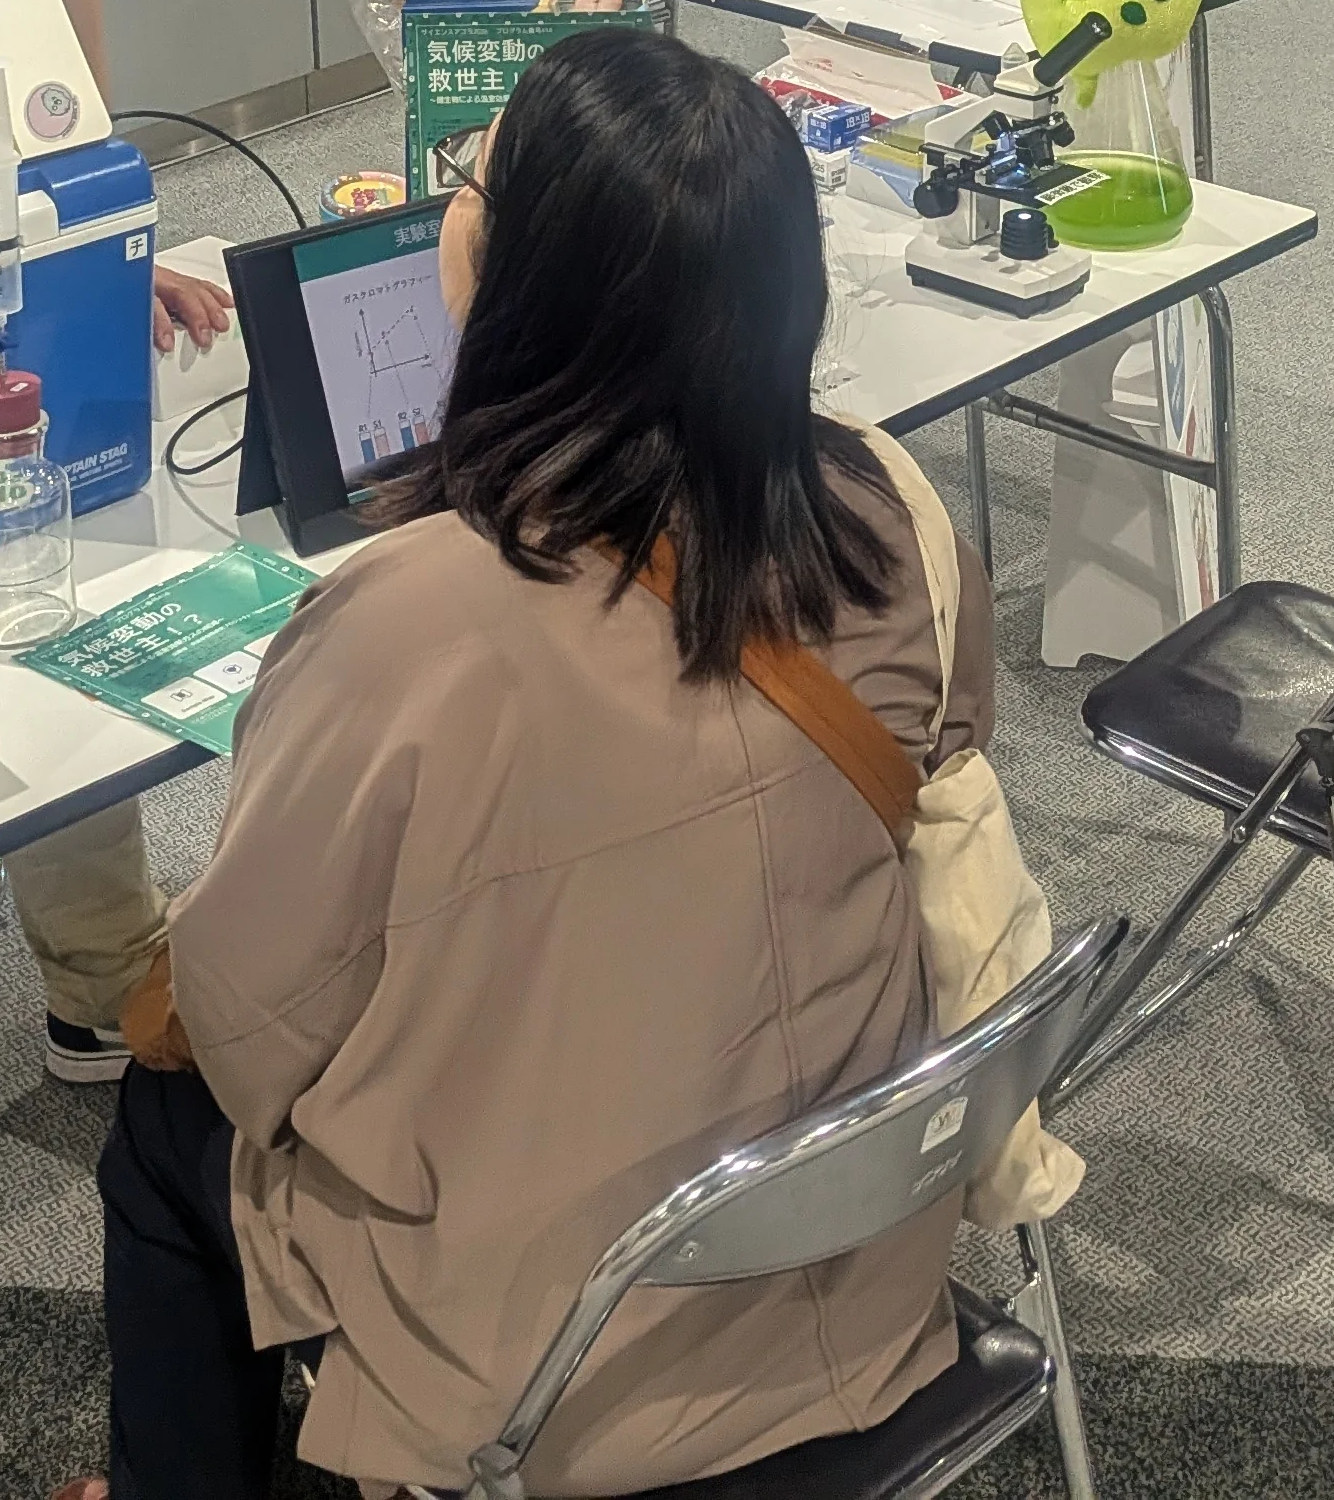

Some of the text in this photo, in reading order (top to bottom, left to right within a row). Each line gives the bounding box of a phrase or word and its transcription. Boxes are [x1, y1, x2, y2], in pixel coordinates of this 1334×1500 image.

[427, 38, 544, 64] 気候変動の
[63, 442, 128, 474] PTAIN STAG
[57, 602, 182, 668] 気候変動の
